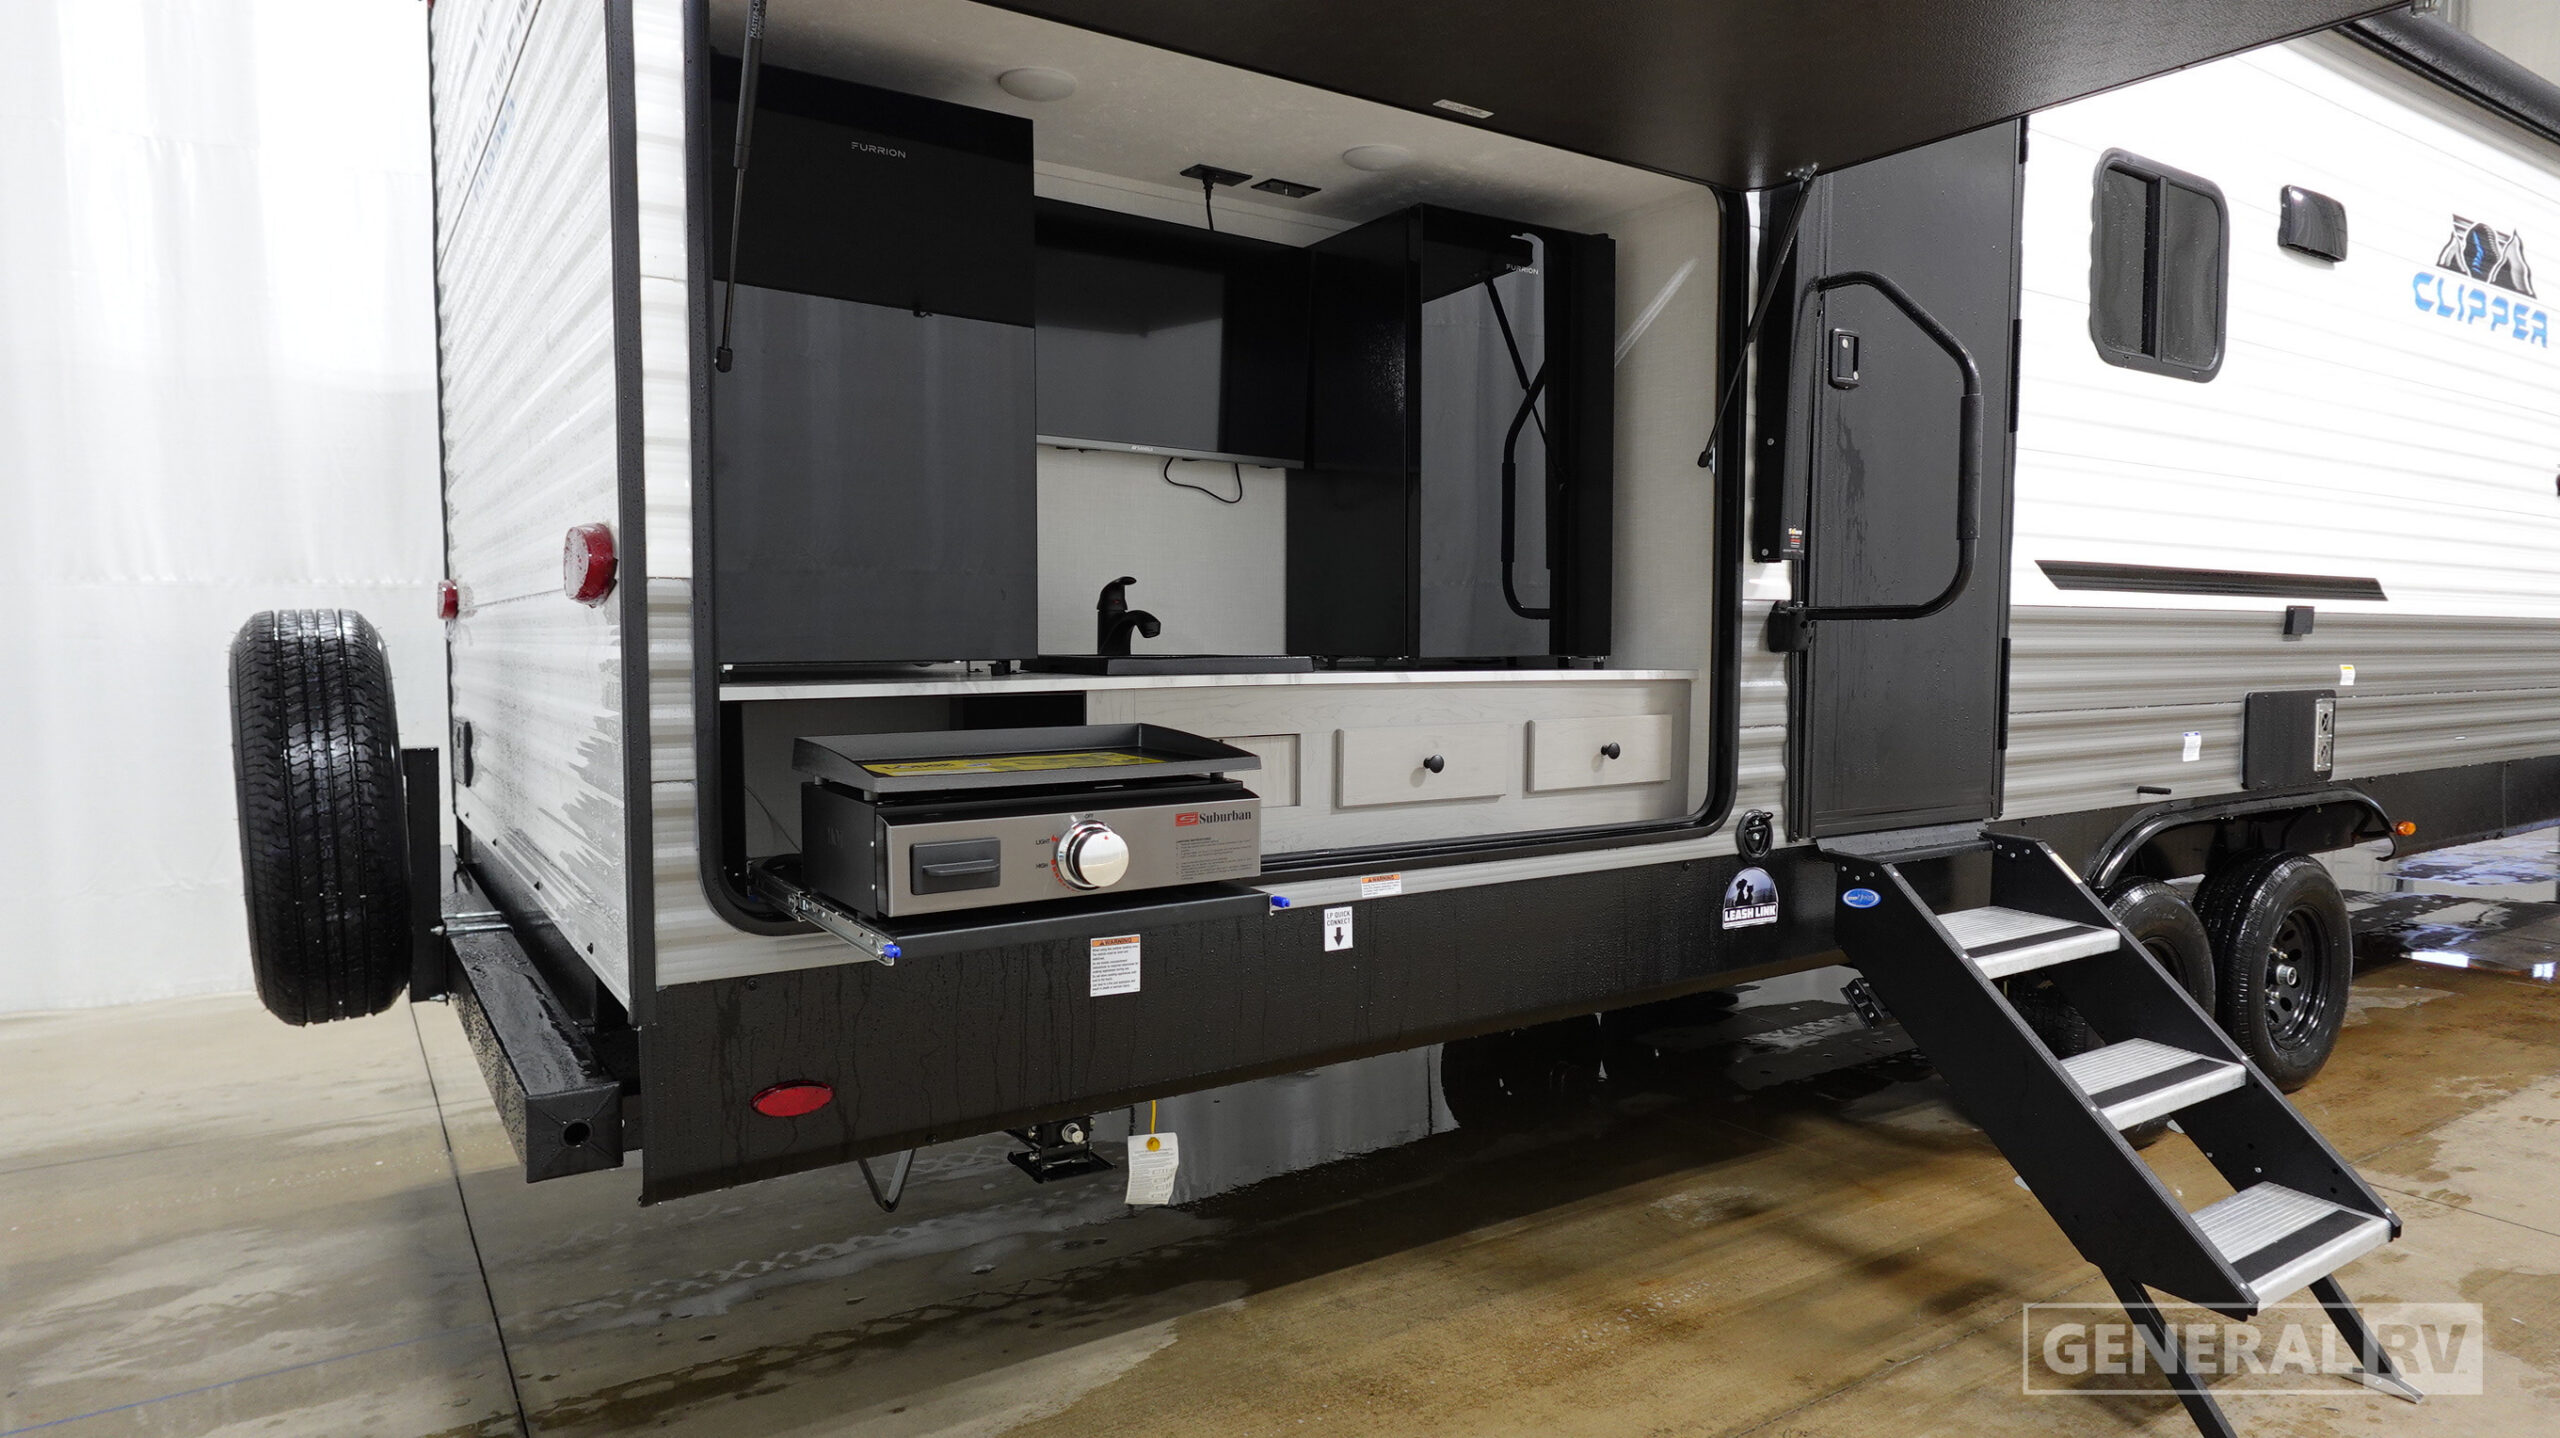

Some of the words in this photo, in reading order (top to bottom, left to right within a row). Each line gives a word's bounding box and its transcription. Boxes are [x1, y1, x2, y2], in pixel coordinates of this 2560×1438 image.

[851, 141, 906, 159] FURRION
[2412, 271, 2548, 348] CLIPPER
[1199, 810, 1252, 824] Suburban
[1334, 910, 1351, 918] QUICK
[1724, 907, 1754, 922] LEASH
[1755, 905, 1776, 918] LINK
[1326, 918, 1351, 926] CONNECT
[1104, 937, 1132, 946] WARNING
